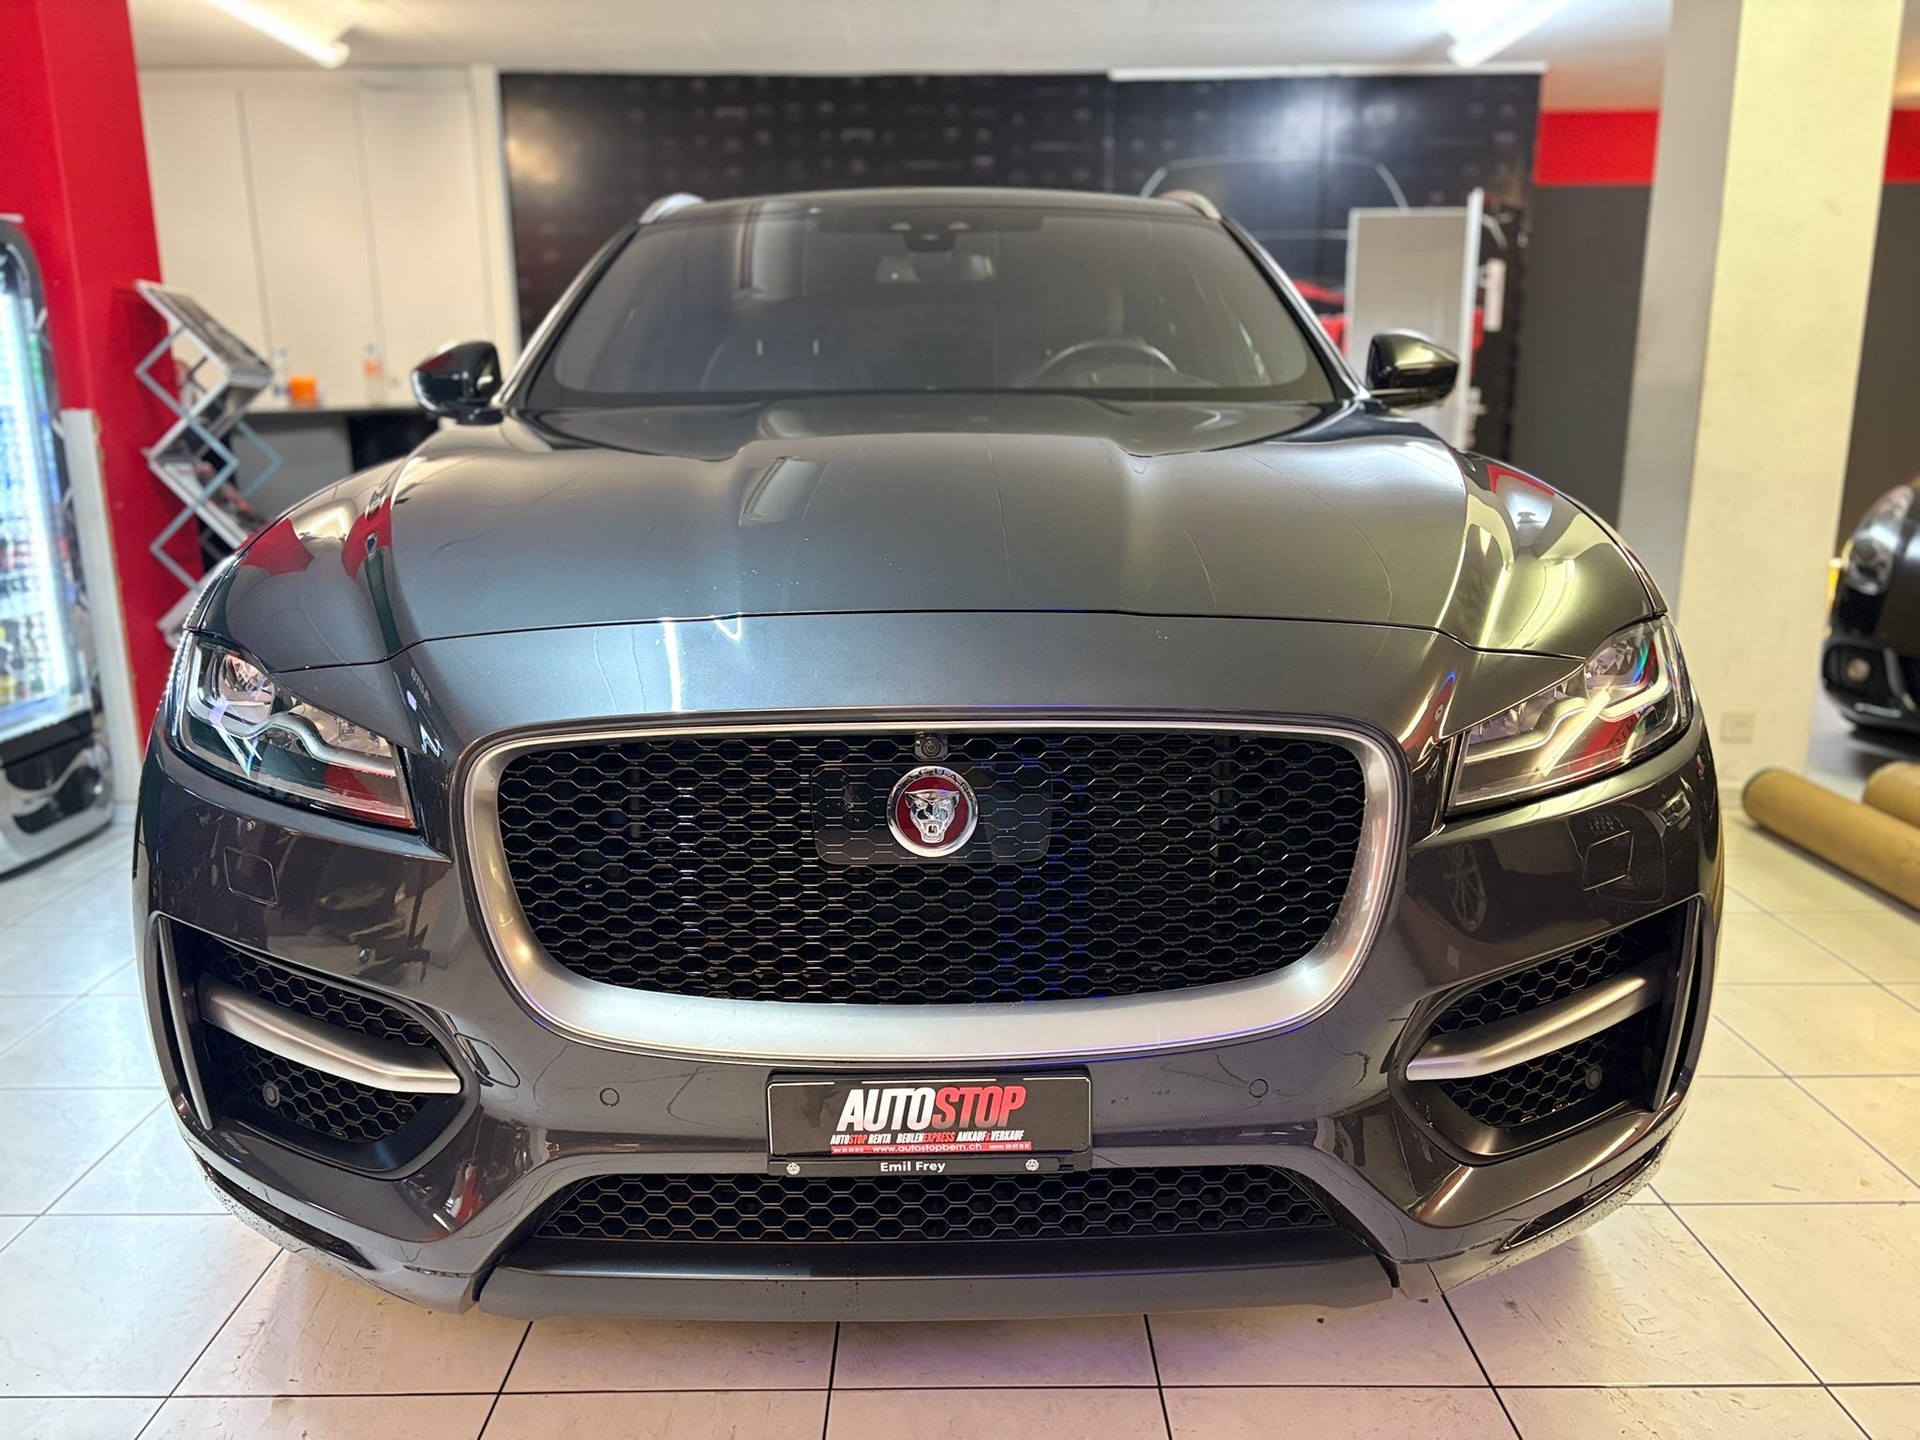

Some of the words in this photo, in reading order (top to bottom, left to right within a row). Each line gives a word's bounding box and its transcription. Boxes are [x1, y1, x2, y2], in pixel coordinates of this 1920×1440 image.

[836, 1085, 1027, 1132] AUTOSTOP
[830, 1133, 868, 1145] AUTOSTOP
[896, 1131, 956, 1144] BEULENEXPRESS
[872, 1143, 982, 1153] www.autostopbern.ch
[880, 1161, 912, 1172] Emil
[915, 1160, 946, 1173] Frey
